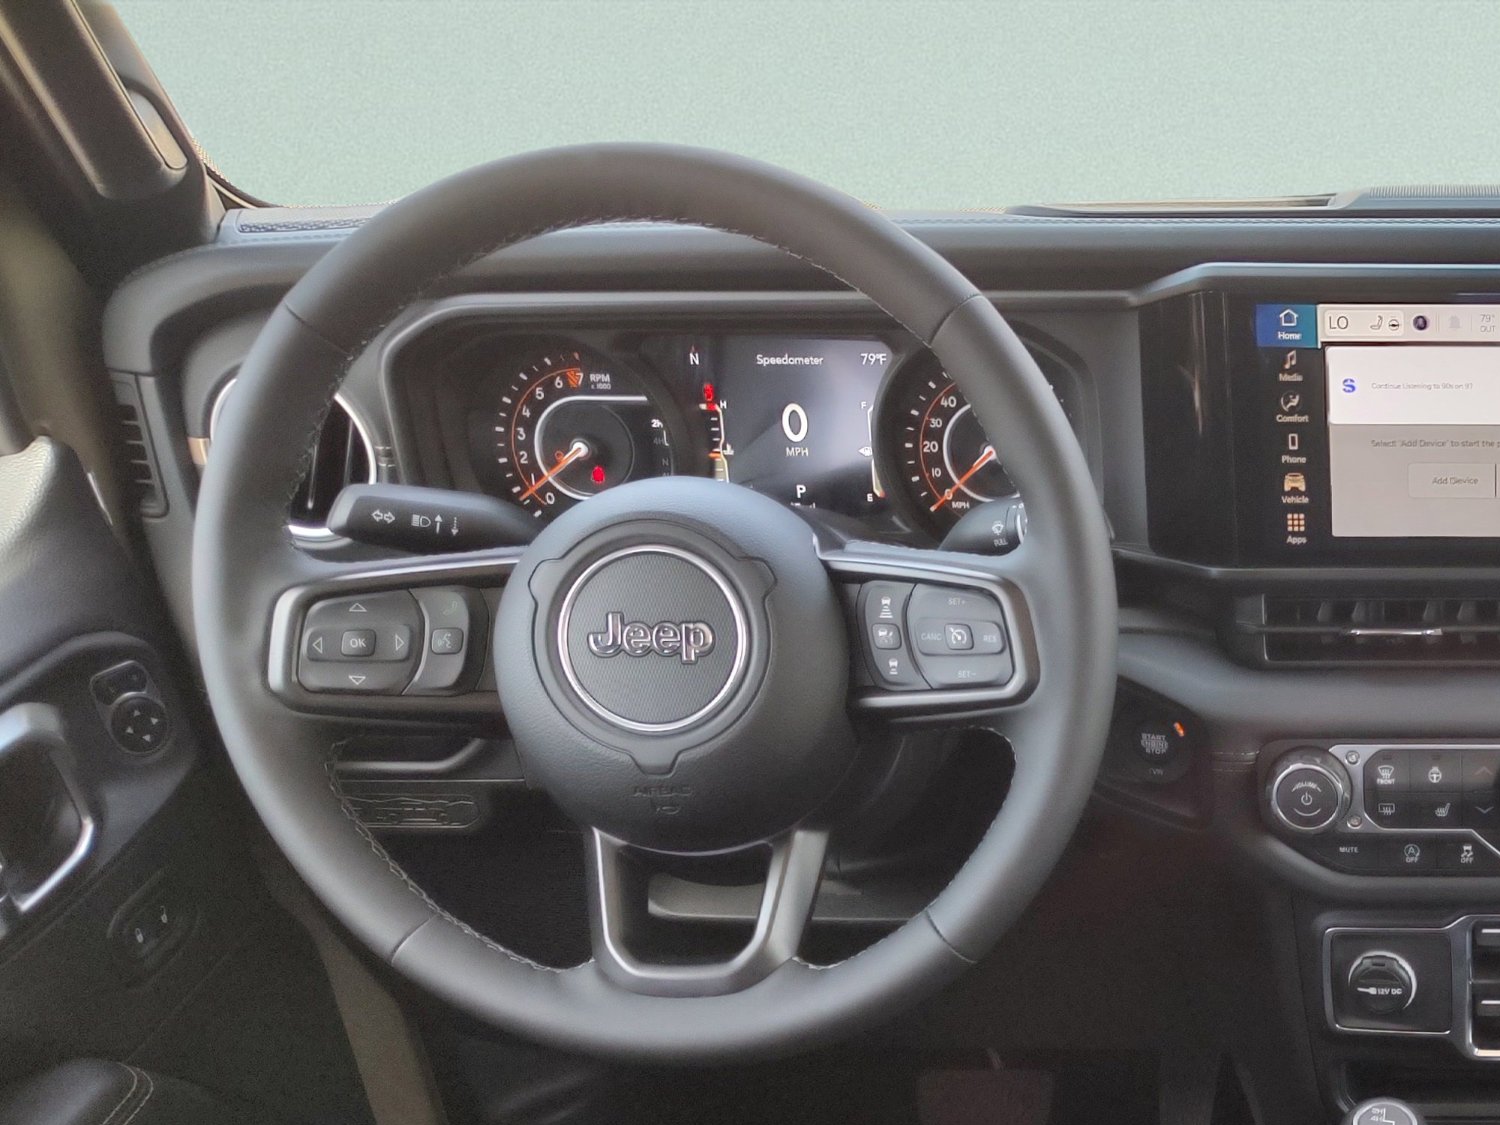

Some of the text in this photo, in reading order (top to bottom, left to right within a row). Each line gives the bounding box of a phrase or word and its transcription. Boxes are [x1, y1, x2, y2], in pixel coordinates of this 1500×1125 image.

[1328, 315, 1349, 330] LO
[1278, 331, 1302, 340] Home
[689, 353, 699, 365] N
[756, 354, 824, 366] Speedometer
[554, 376, 564, 389] 6
[589, 373, 611, 382] RPM
[535, 387, 545, 400] 5
[940, 395, 957, 408] 40
[522, 406, 531, 418] 4
[781, 402, 808, 443] 0
[929, 418, 942, 428] 30
[1276, 414, 1309, 423] Comfort
[516, 427, 526, 441] 3
[786, 447, 809, 457] MPH
[923, 441, 938, 453] 20
[520, 451, 529, 464] 2
[1281, 455, 1307, 464] Phone
[931, 467, 942, 478] 10
[1431, 476, 1479, 485] Add Device
[796, 484, 807, 499] P
[545, 491, 555, 505] 0
[1281, 495, 1309, 504] Vehicle
[952, 501, 970, 509] MPH
[1286, 535, 1307, 545] Apps
[587, 611, 716, 665] Jeep
[921, 632, 942, 641] CANC
[983, 635, 997, 643] RES
[350, 638, 367, 648] OK
[1377, 987, 1403, 995] 12V DC
